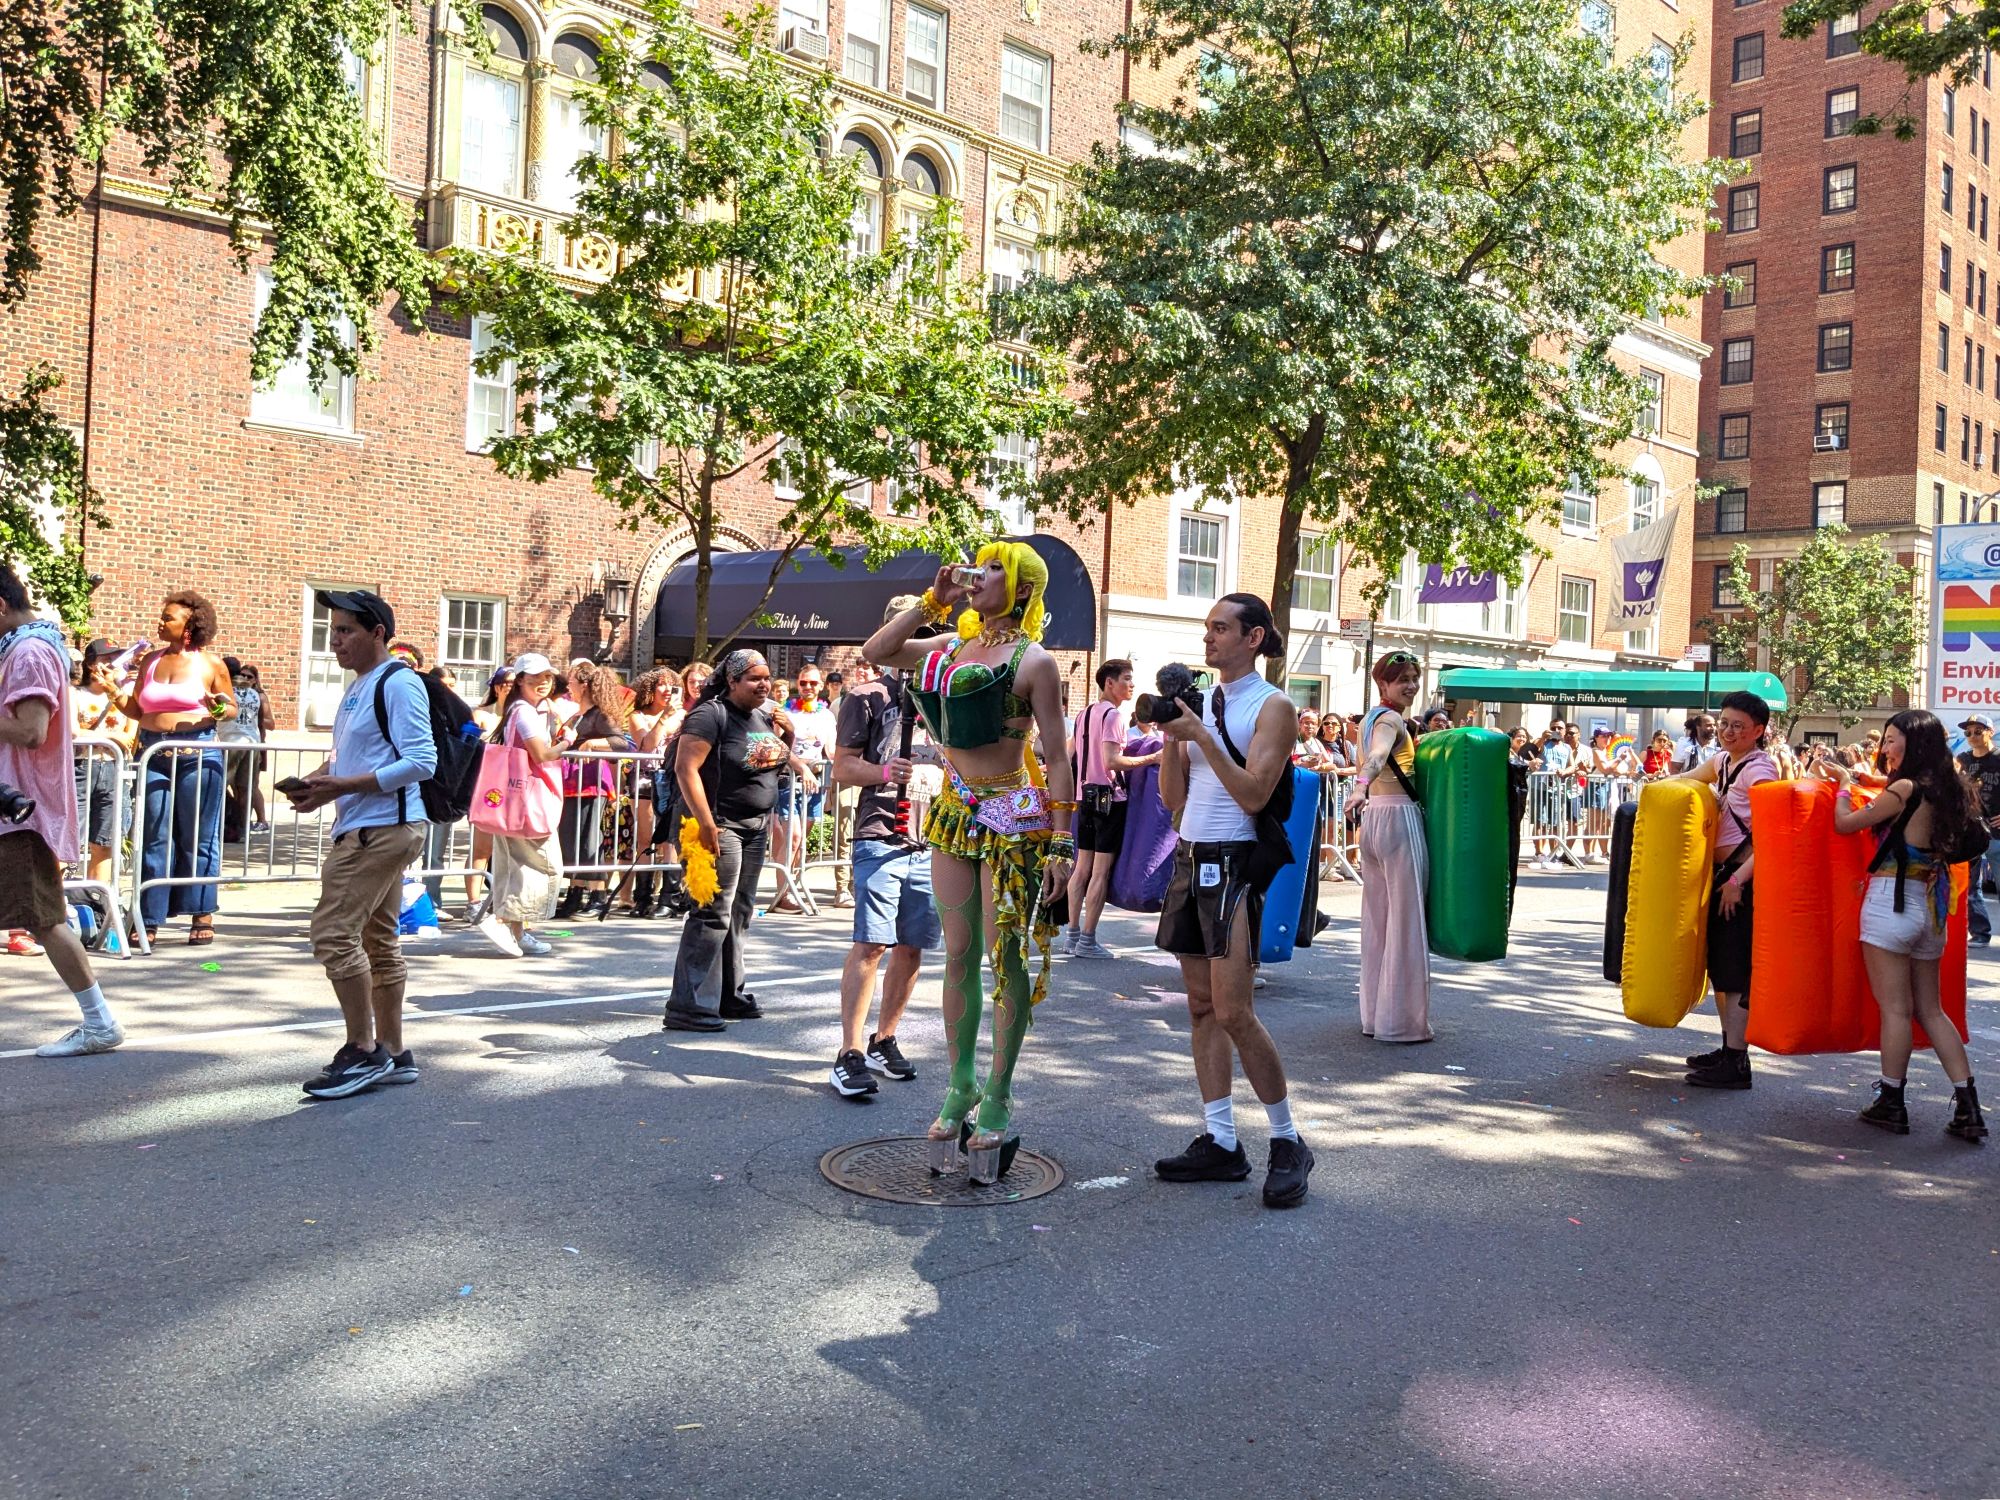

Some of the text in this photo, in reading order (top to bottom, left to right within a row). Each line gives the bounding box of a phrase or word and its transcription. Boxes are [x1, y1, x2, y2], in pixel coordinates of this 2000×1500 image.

[1438, 568, 1485, 588] NYU
[770, 612, 830, 635] Thirty Nine
[1533, 692, 1628, 704] Thirty Five Fifth Avenue
